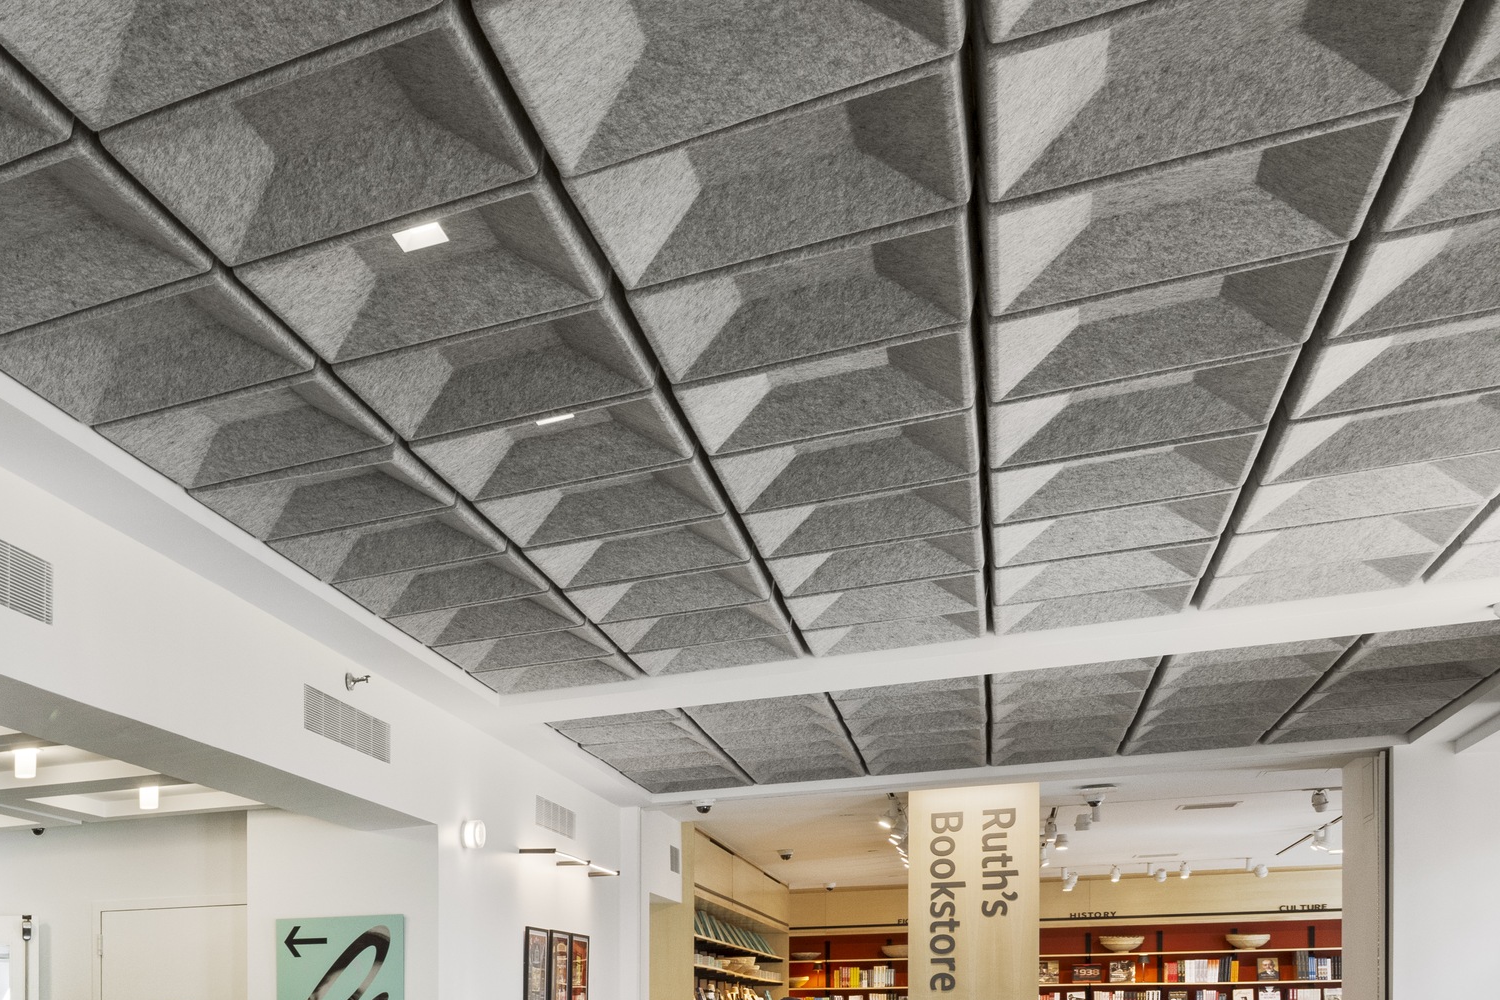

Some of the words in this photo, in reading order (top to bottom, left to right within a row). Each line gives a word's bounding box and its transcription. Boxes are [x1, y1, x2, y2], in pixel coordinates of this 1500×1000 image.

[930, 811, 966, 992] Bookstore
[1279, 904, 1327, 912] CULTURE
[1070, 911, 1116, 919] HISTORY
